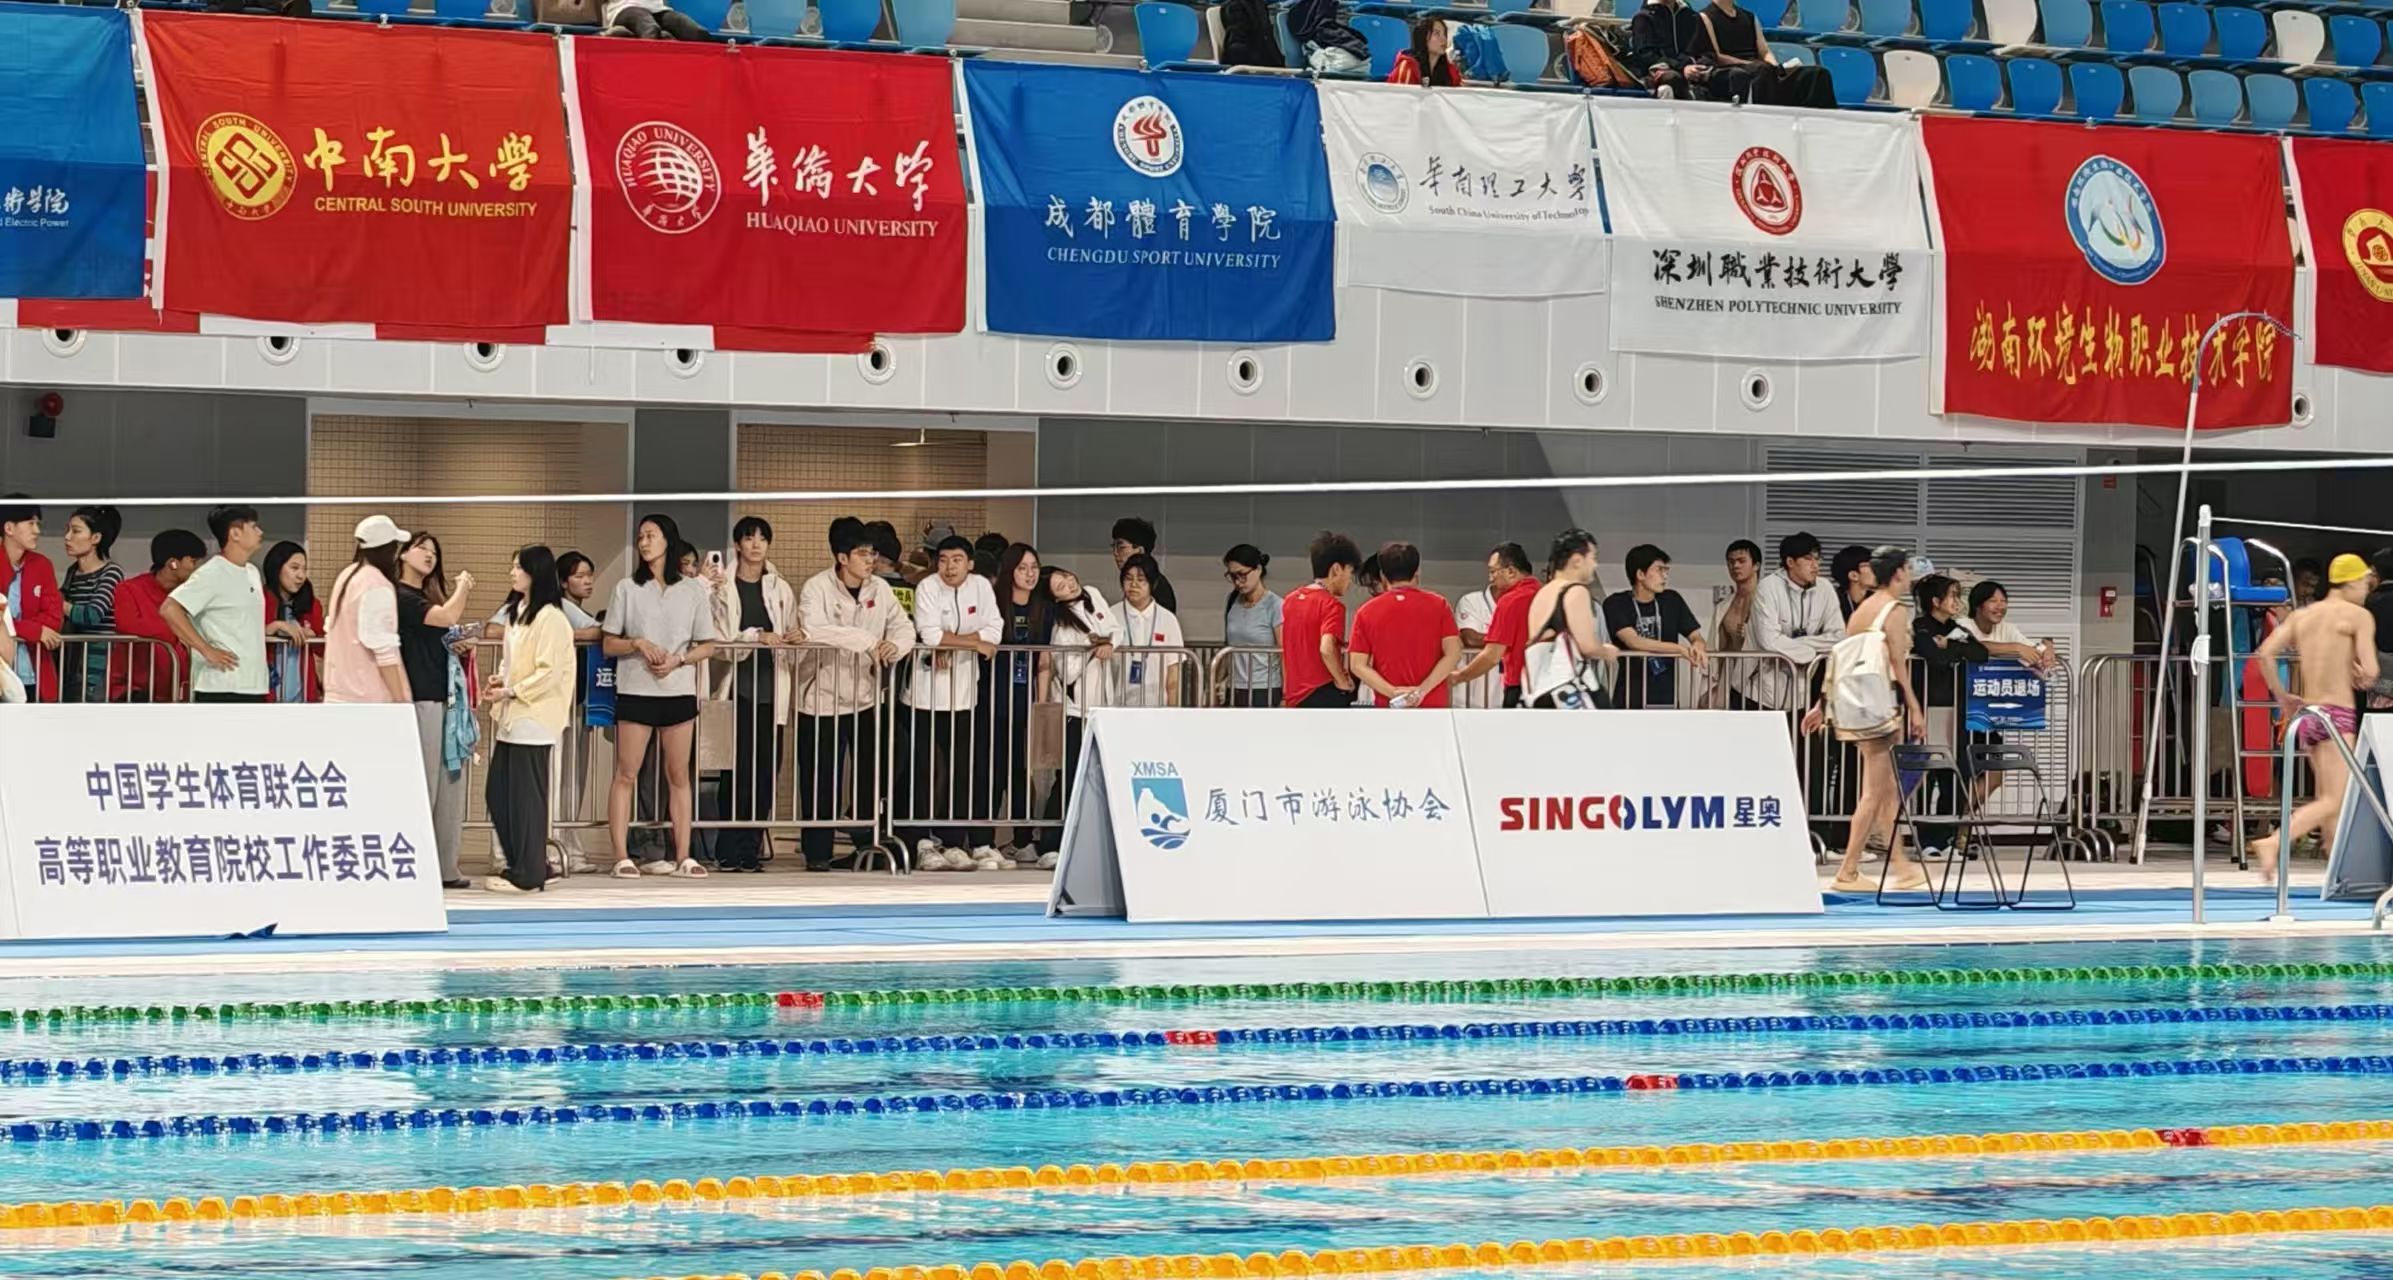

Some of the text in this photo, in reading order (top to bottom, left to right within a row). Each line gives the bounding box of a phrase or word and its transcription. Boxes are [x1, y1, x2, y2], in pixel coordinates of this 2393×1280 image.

[621, 127, 716, 193] HUAQIAO UNIVERSITY
[314, 197, 538, 217] CENTRAL SOUTH UNIVERSITY
[1045, 195, 1281, 243] 成都體育學院
[1428, 206, 1456, 216] South
[1457, 206, 1482, 218] China
[1483, 210, 1530, 221] University
[4, 217, 39, 228] Electric
[40, 217, 70, 227] Power
[746, 212, 939, 237] HUAQIAO UNIVERSITY
[1047, 246, 1281, 269] CHENGDU SPORT UNIVERSITY
[1652, 248, 1903, 292] 深圳職業技術大學
[1655, 295, 1903, 316] SHENZHEN POLYTECHNIC UNIVERSITY
[1970, 299, 2277, 389] 湖南环境生物职业技术学院
[596, 667, 617, 687] 运
[1973, 678, 2040, 697] 运动员退场
[1132, 761, 1178, 777] XMSA
[86, 760, 349, 811] 中国学生体育联合会
[1204, 786, 1451, 825] 厦门市游泳协会
[1500, 795, 1782, 831] SINGOLYM 星奥
[34, 832, 418, 885] 高等职业教育院校工作委员会
